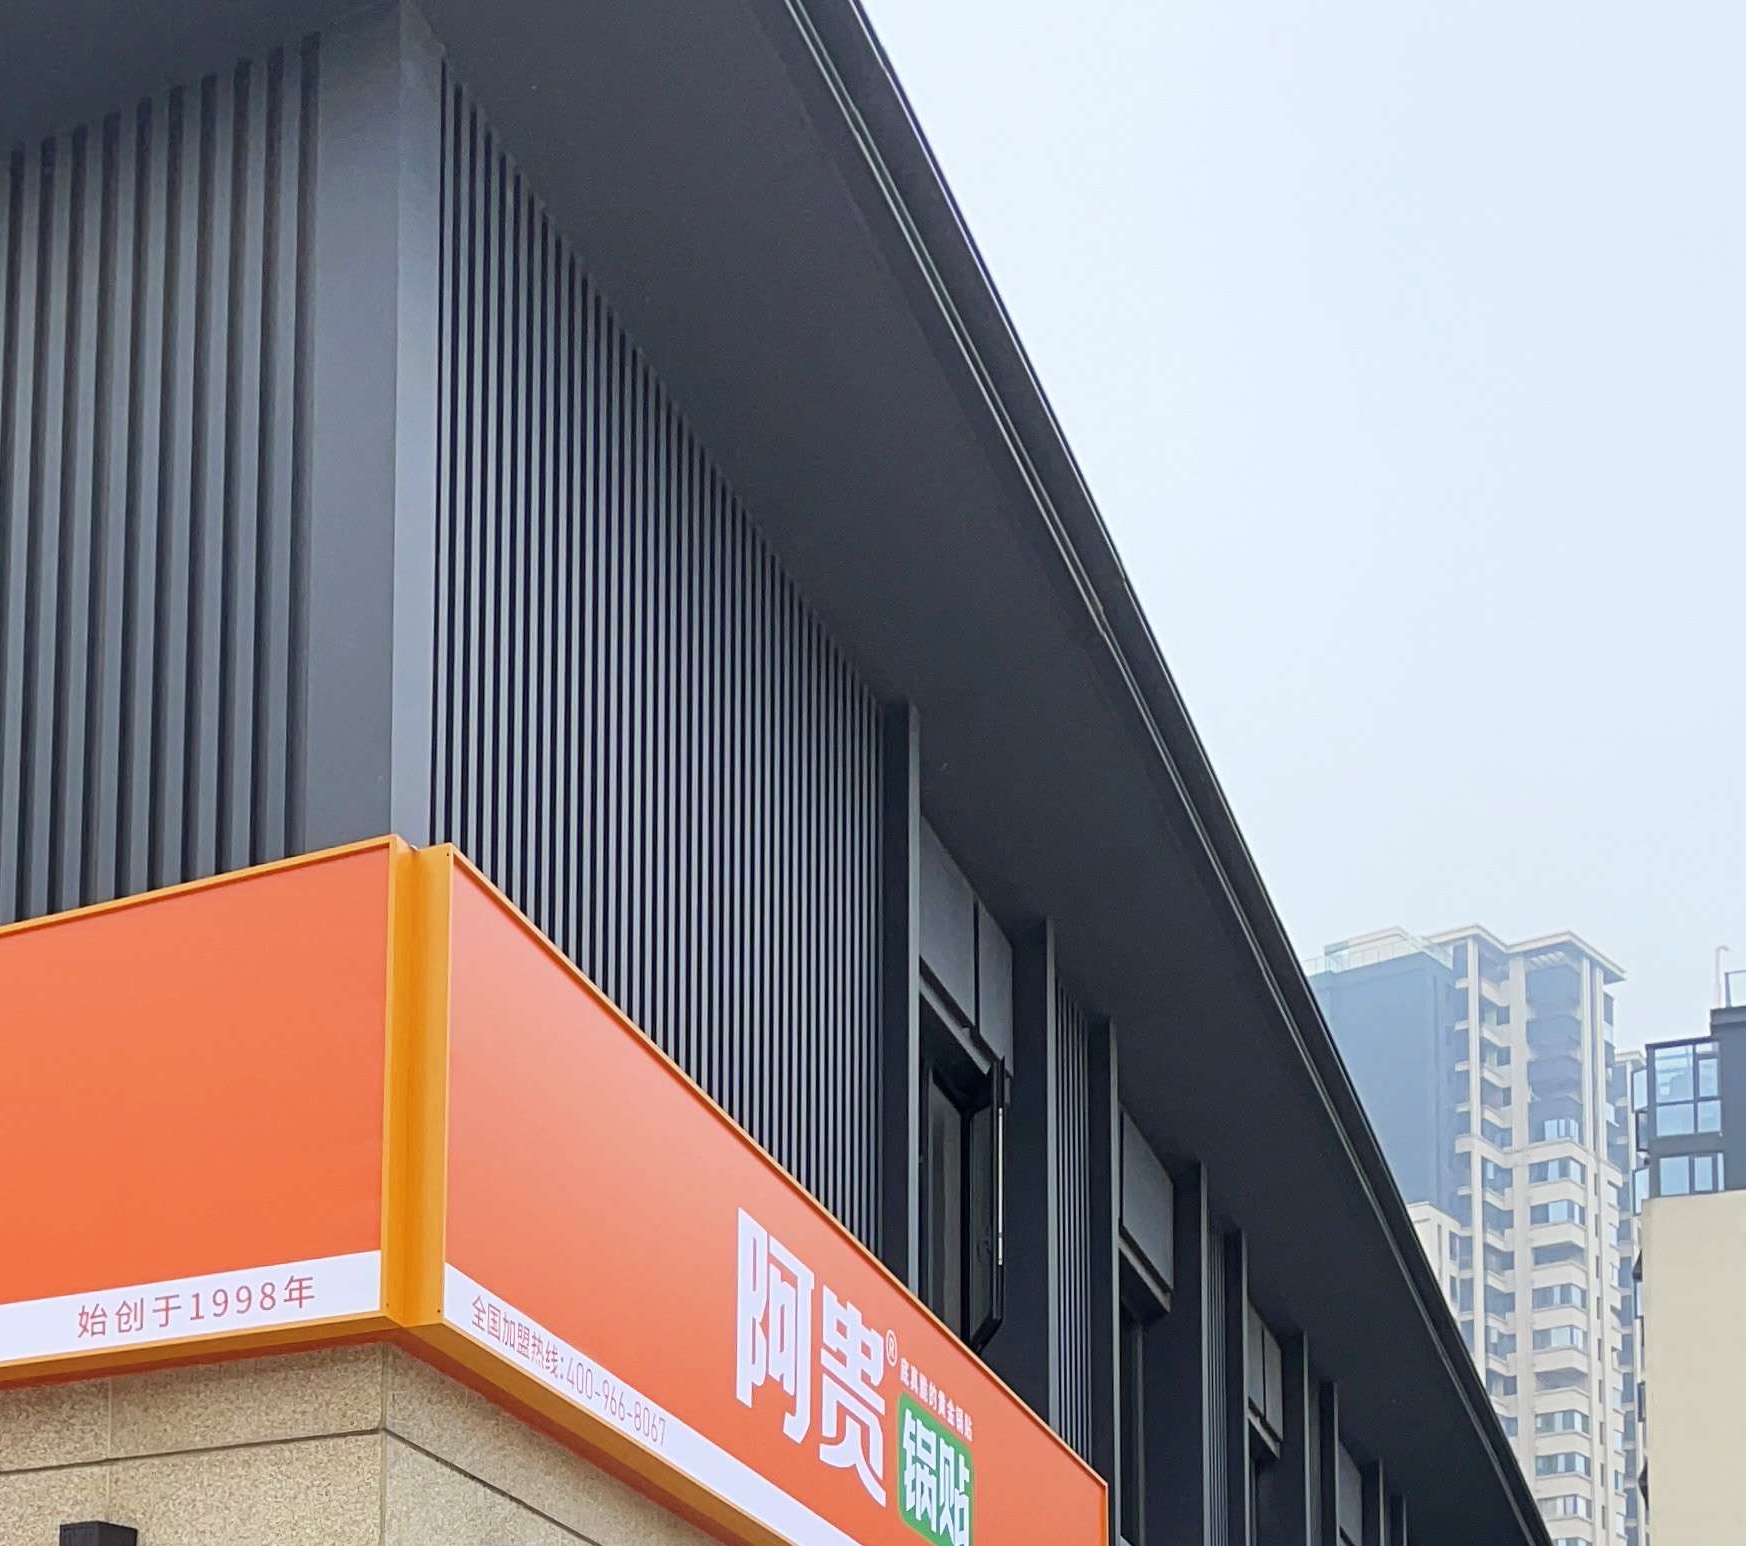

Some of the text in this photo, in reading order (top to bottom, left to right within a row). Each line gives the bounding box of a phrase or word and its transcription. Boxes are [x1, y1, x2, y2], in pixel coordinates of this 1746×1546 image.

[77, 1274, 316, 1338] 始创于1998年
[736, 1206, 886, 1507] 阿贵
